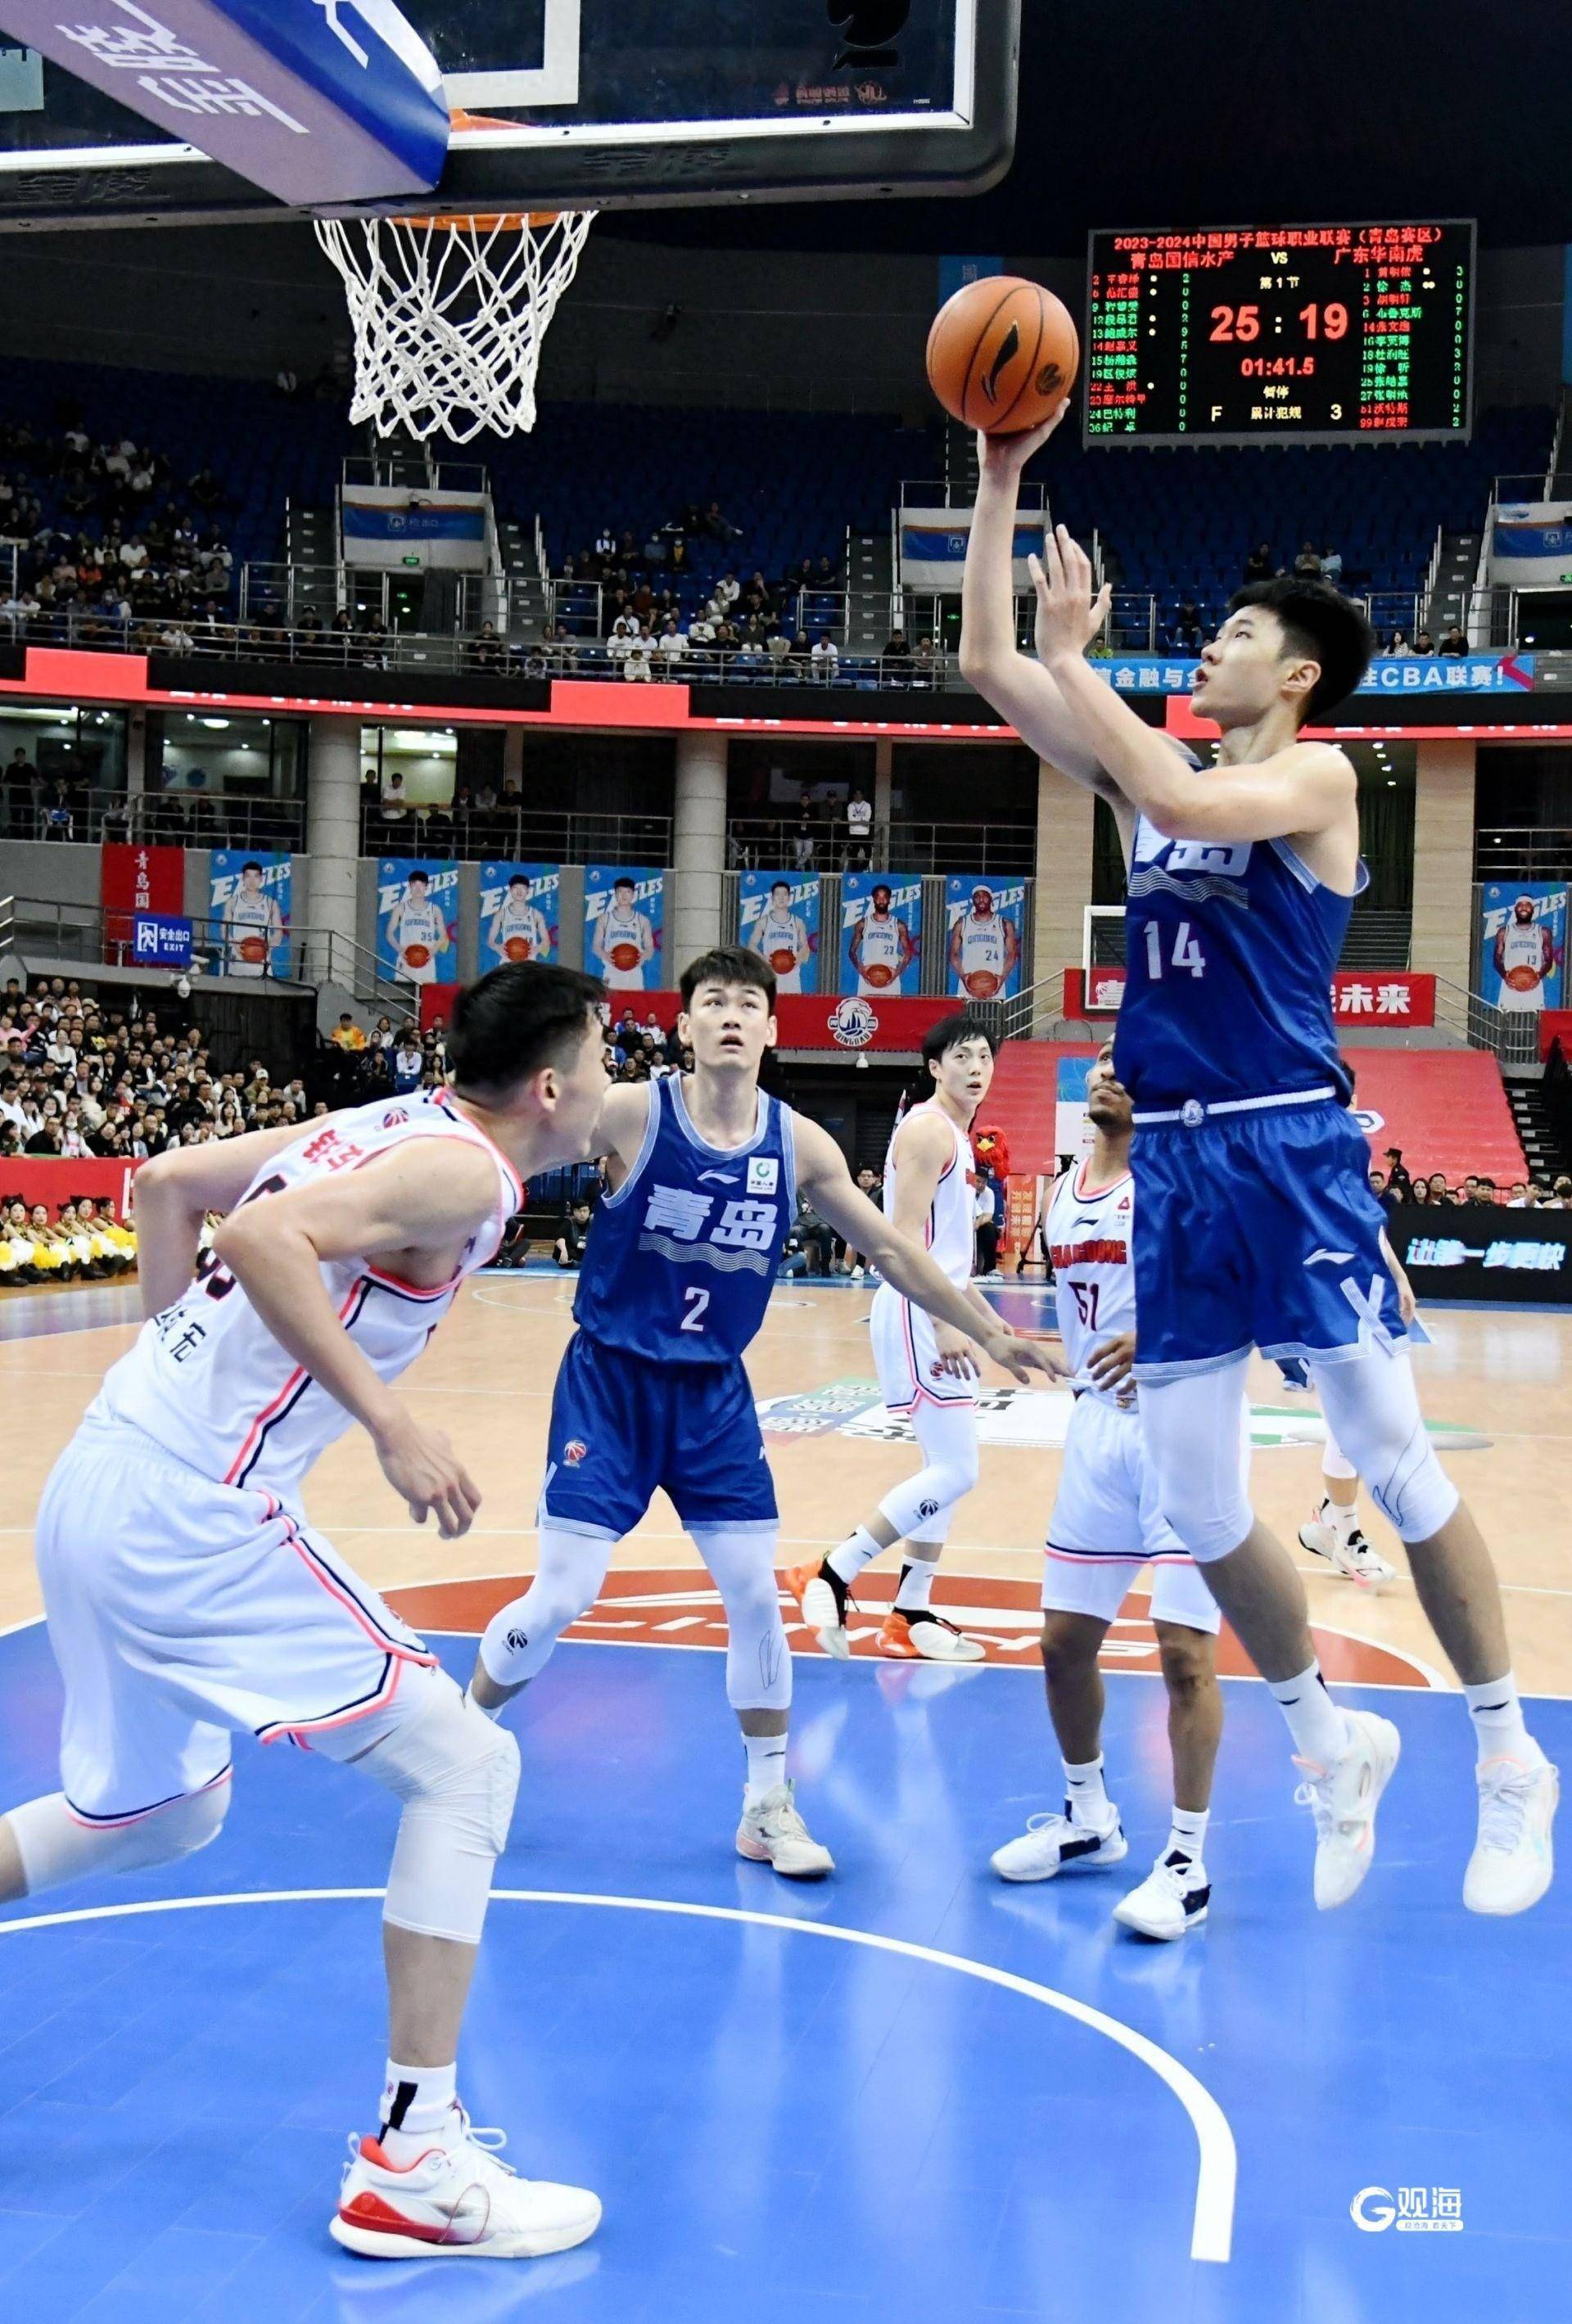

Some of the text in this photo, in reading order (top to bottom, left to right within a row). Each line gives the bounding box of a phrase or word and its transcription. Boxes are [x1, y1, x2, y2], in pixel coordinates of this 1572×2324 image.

[1131, 244, 1423, 269] 青岛国信水产 VS 广东华南虎
[1366, 269, 1369, 278] 1
[1457, 266, 1463, 276] 3
[1093, 275, 1099, 285] 2
[1183, 273, 1189, 283] 2
[1363, 283, 1370, 291] 2
[1457, 281, 1462, 289] 0
[1091, 290, 1099, 298] 6
[1182, 288, 1189, 296] 0
[1363, 296, 1370, 305] 3
[1456, 294, 1462, 303] 0
[1092, 303, 1099, 312] 9
[1182, 300, 1189, 310] 0
[1362, 309, 1369, 318] 6
[1456, 307, 1462, 315] 7
[1094, 316, 1104, 324] 12
[1182, 314, 1188, 322] 2
[1209, 305, 1260, 341] 25
[1299, 303, 1348, 340] 19
[1364, 323, 1376, 332] 14
[1455, 320, 1461, 331] 0
[1093, 329, 1104, 339] 13
[1181, 327, 1188, 336] 9
[1364, 336, 1375, 345] 16
[1455, 335, 1461, 343] 0
[1094, 342, 1104, 351] 14
[1181, 341, 1187, 349] 5
[1092, 356, 1103, 365] 15
[1181, 354, 1186, 363] 7
[1363, 350, 1376, 360] 18
[1455, 348, 1461, 358] 3
[1241, 357, 1314, 377] 01:41.5
[1363, 364, 1375, 372] 19
[1454, 362, 1461, 371] 2
[1092, 370, 1103, 378] 19
[1181, 368, 1186, 377] 0
[1180, 381, 1186, 390] 0
[1454, 376, 1460, 385] 0
[1090, 395, 1102, 405] 23
[1180, 395, 1186, 404] 0
[1361, 390, 1375, 401] 27
[1453, 390, 1460, 399] 0
[1090, 410, 1101, 418] 24
[1180, 408, 1186, 417] 0
[1212, 406, 1222, 422] F
[1330, 404, 1342, 420] 3
[1453, 404, 1459, 413] 2
[1179, 422, 1186, 431] 0
[1360, 417, 1374, 428] 99
[1453, 417, 1459, 426] 2
[159, 927, 190, 942] 安全出口
[421, 932, 431, 941] 35
[164, 941, 184, 951] EXIT
[884, 945, 894, 954] 23
[1143, 921, 1206, 979] 14
[986, 950, 998, 961] 24
[1527, 954, 1537, 964] 13
[1330, 983, 1411, 1013] 未来
[643, 1184, 778, 1250] 青岛
[680, 1286, 710, 1332] 2
[1068, 1281, 1099, 1332] 51
